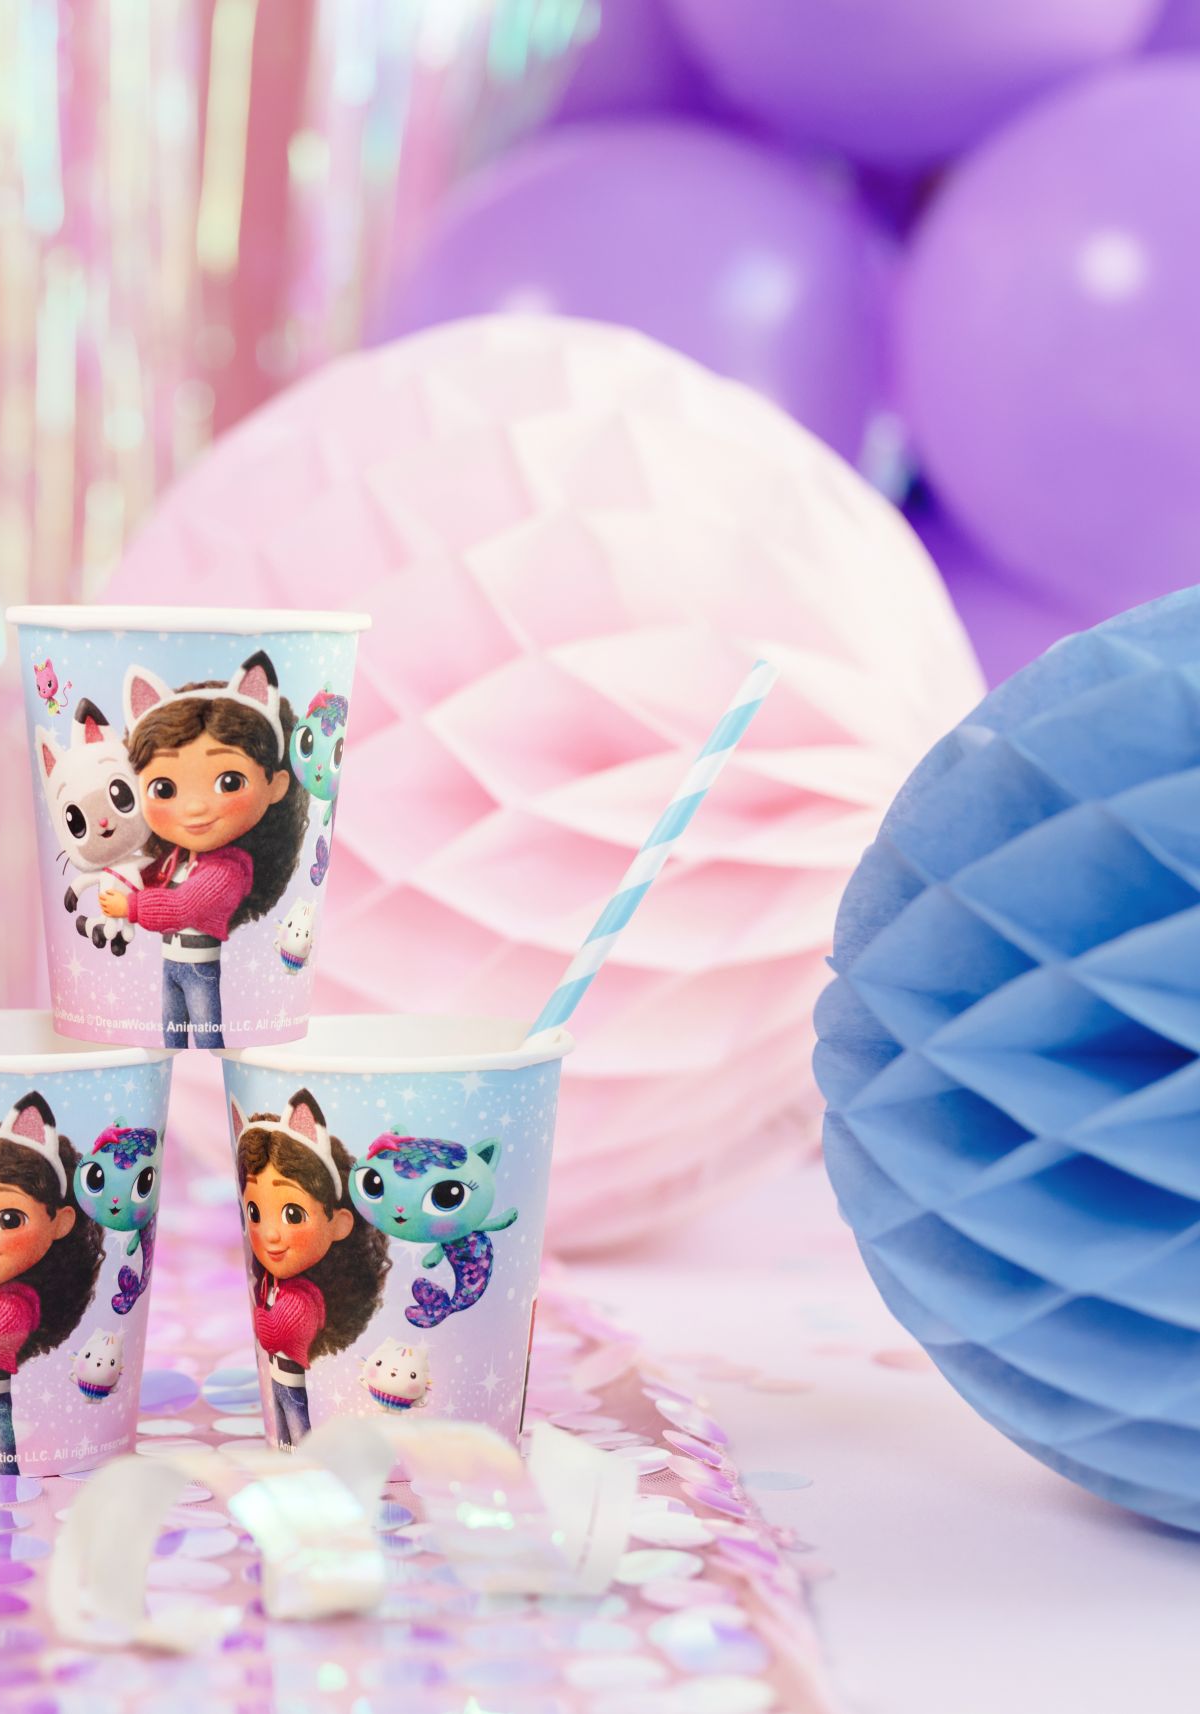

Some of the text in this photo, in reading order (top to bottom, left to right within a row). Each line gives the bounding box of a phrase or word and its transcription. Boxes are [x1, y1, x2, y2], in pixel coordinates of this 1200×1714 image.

[95, 1015, 163, 1032] DreamWorks
[166, 1020, 226, 1033] Animation
[229, 1020, 254, 1033] LLC.
[255, 1018, 268, 1031] All
[24, 1449, 52, 1462] LLC.
[53, 1447, 69, 1460] All
[71, 1443, 99, 1460] rights
